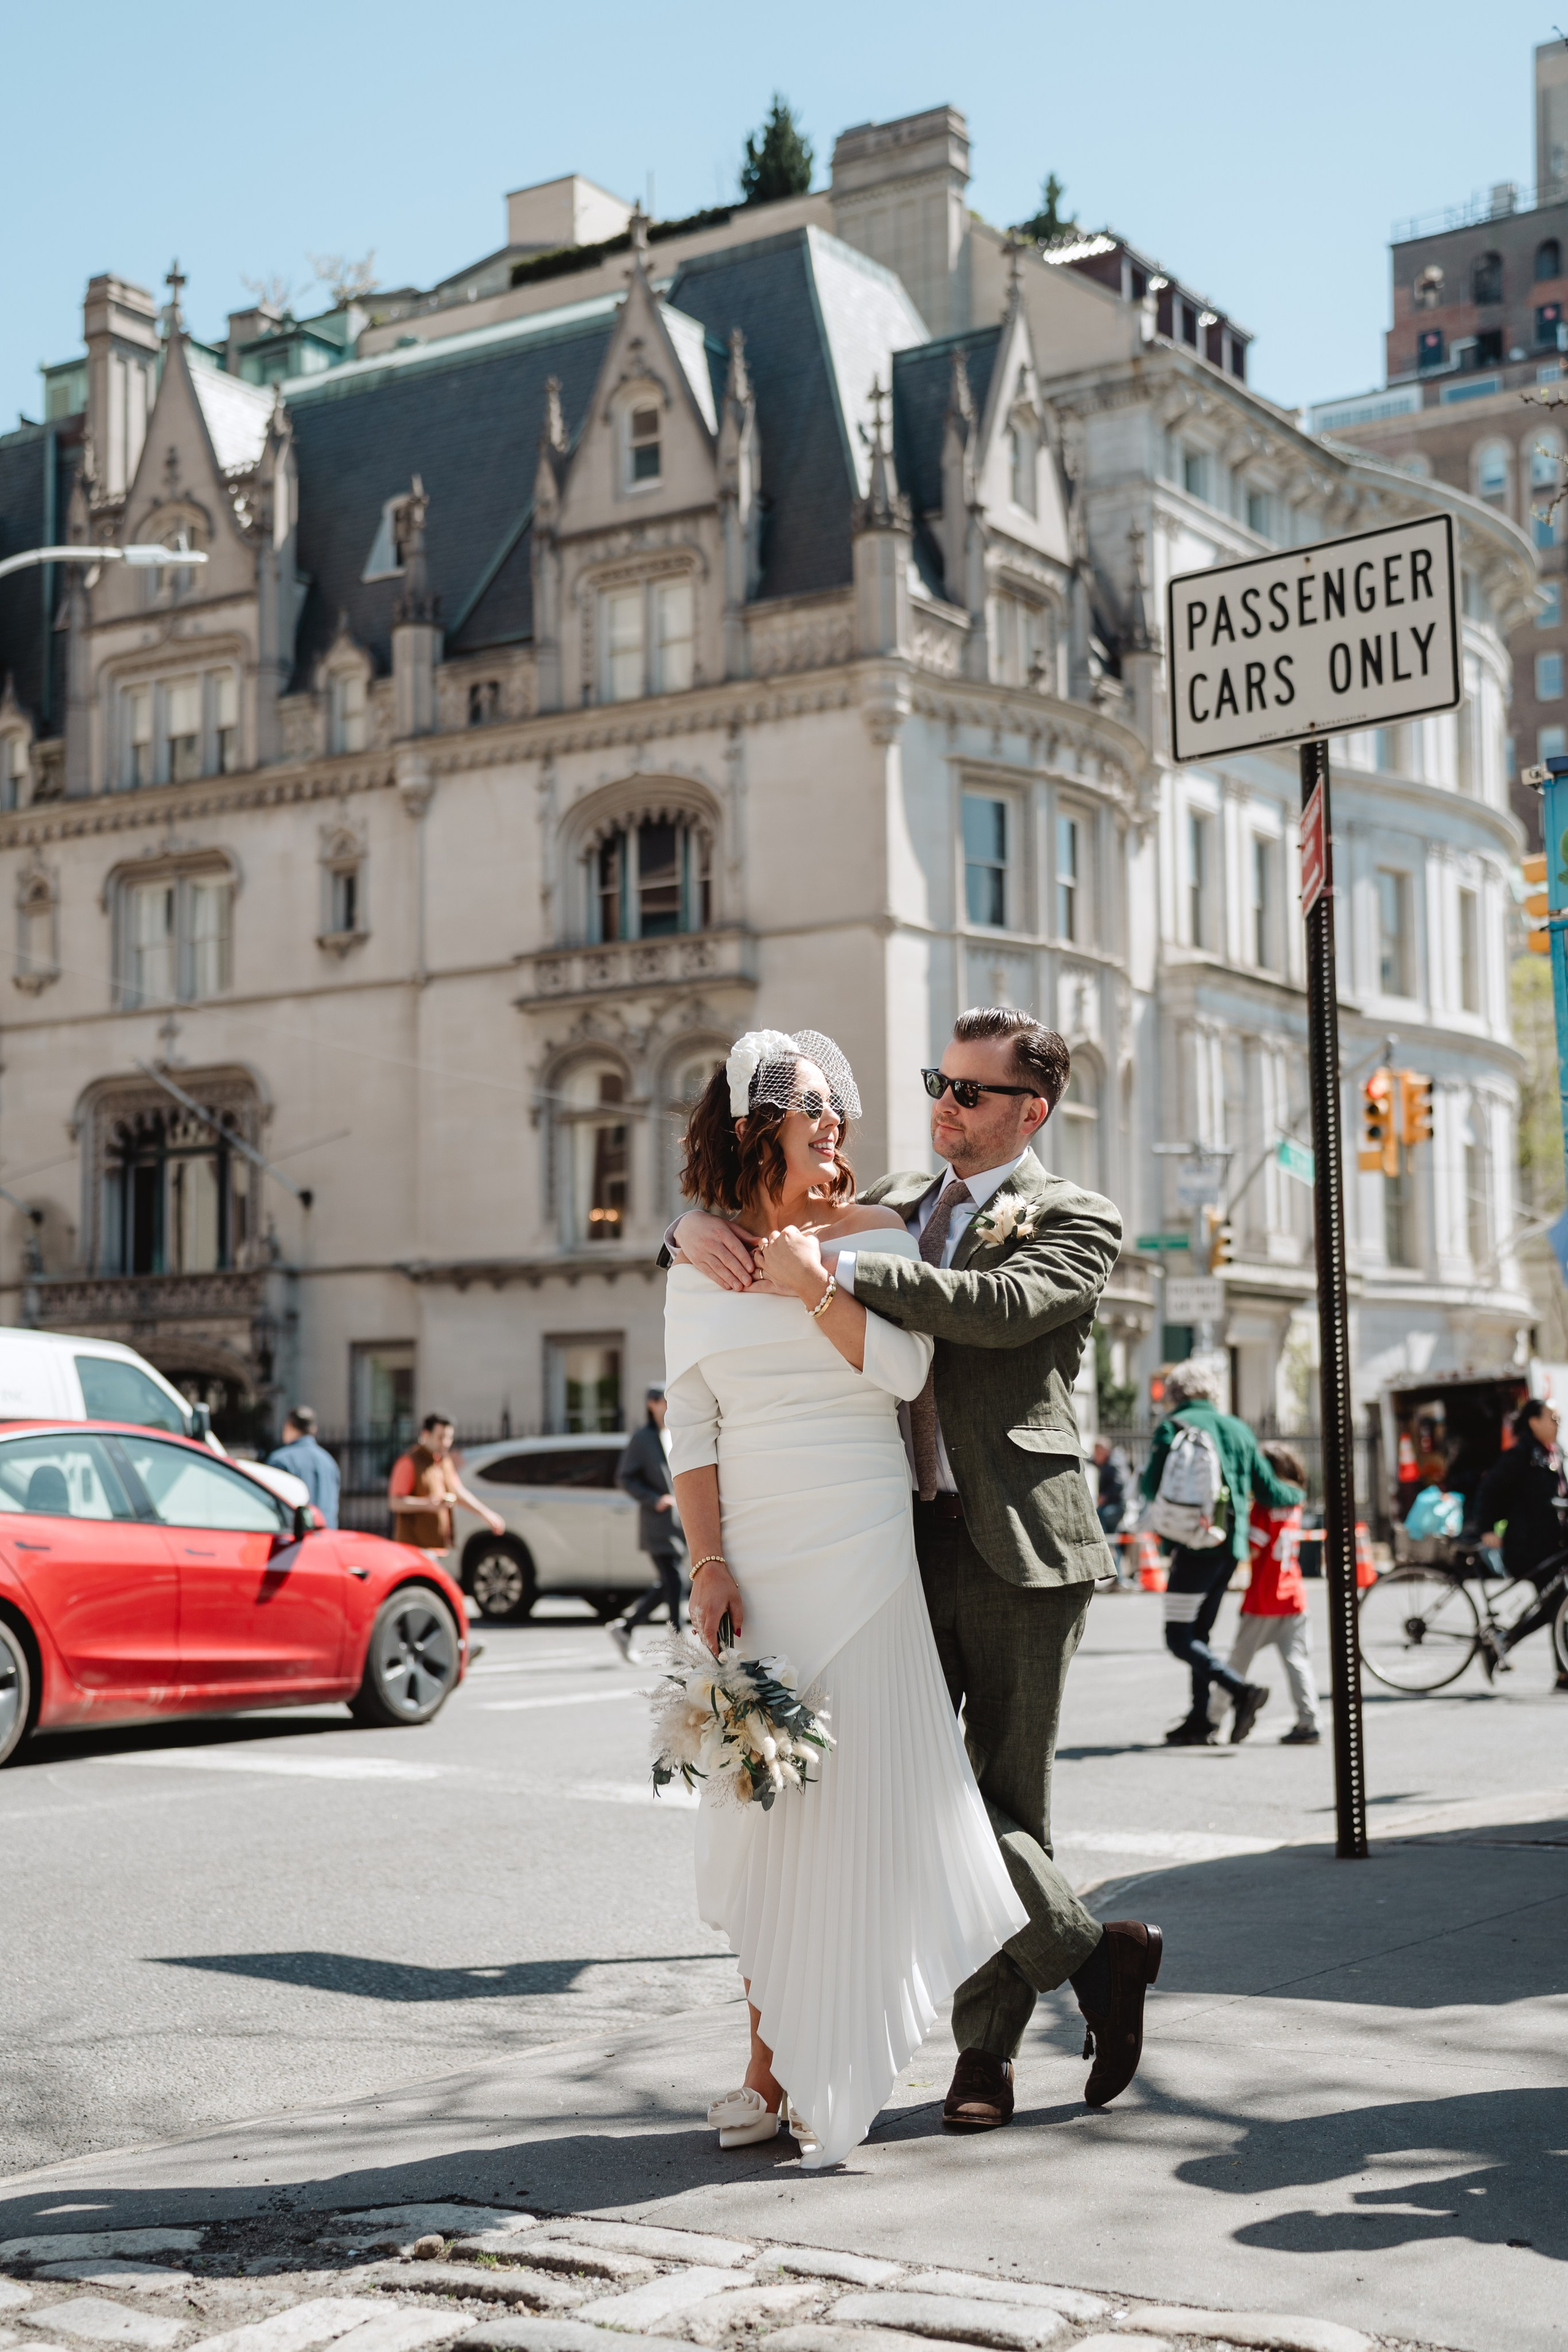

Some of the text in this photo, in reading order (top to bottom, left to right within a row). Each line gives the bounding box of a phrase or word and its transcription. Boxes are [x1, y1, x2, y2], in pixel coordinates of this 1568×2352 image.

[1186, 548, 1433, 652] PASSENGER
[1188, 622, 1436, 724] CARS ONLY
[1302, 713, 1367, 731] TRNSPORTATION
